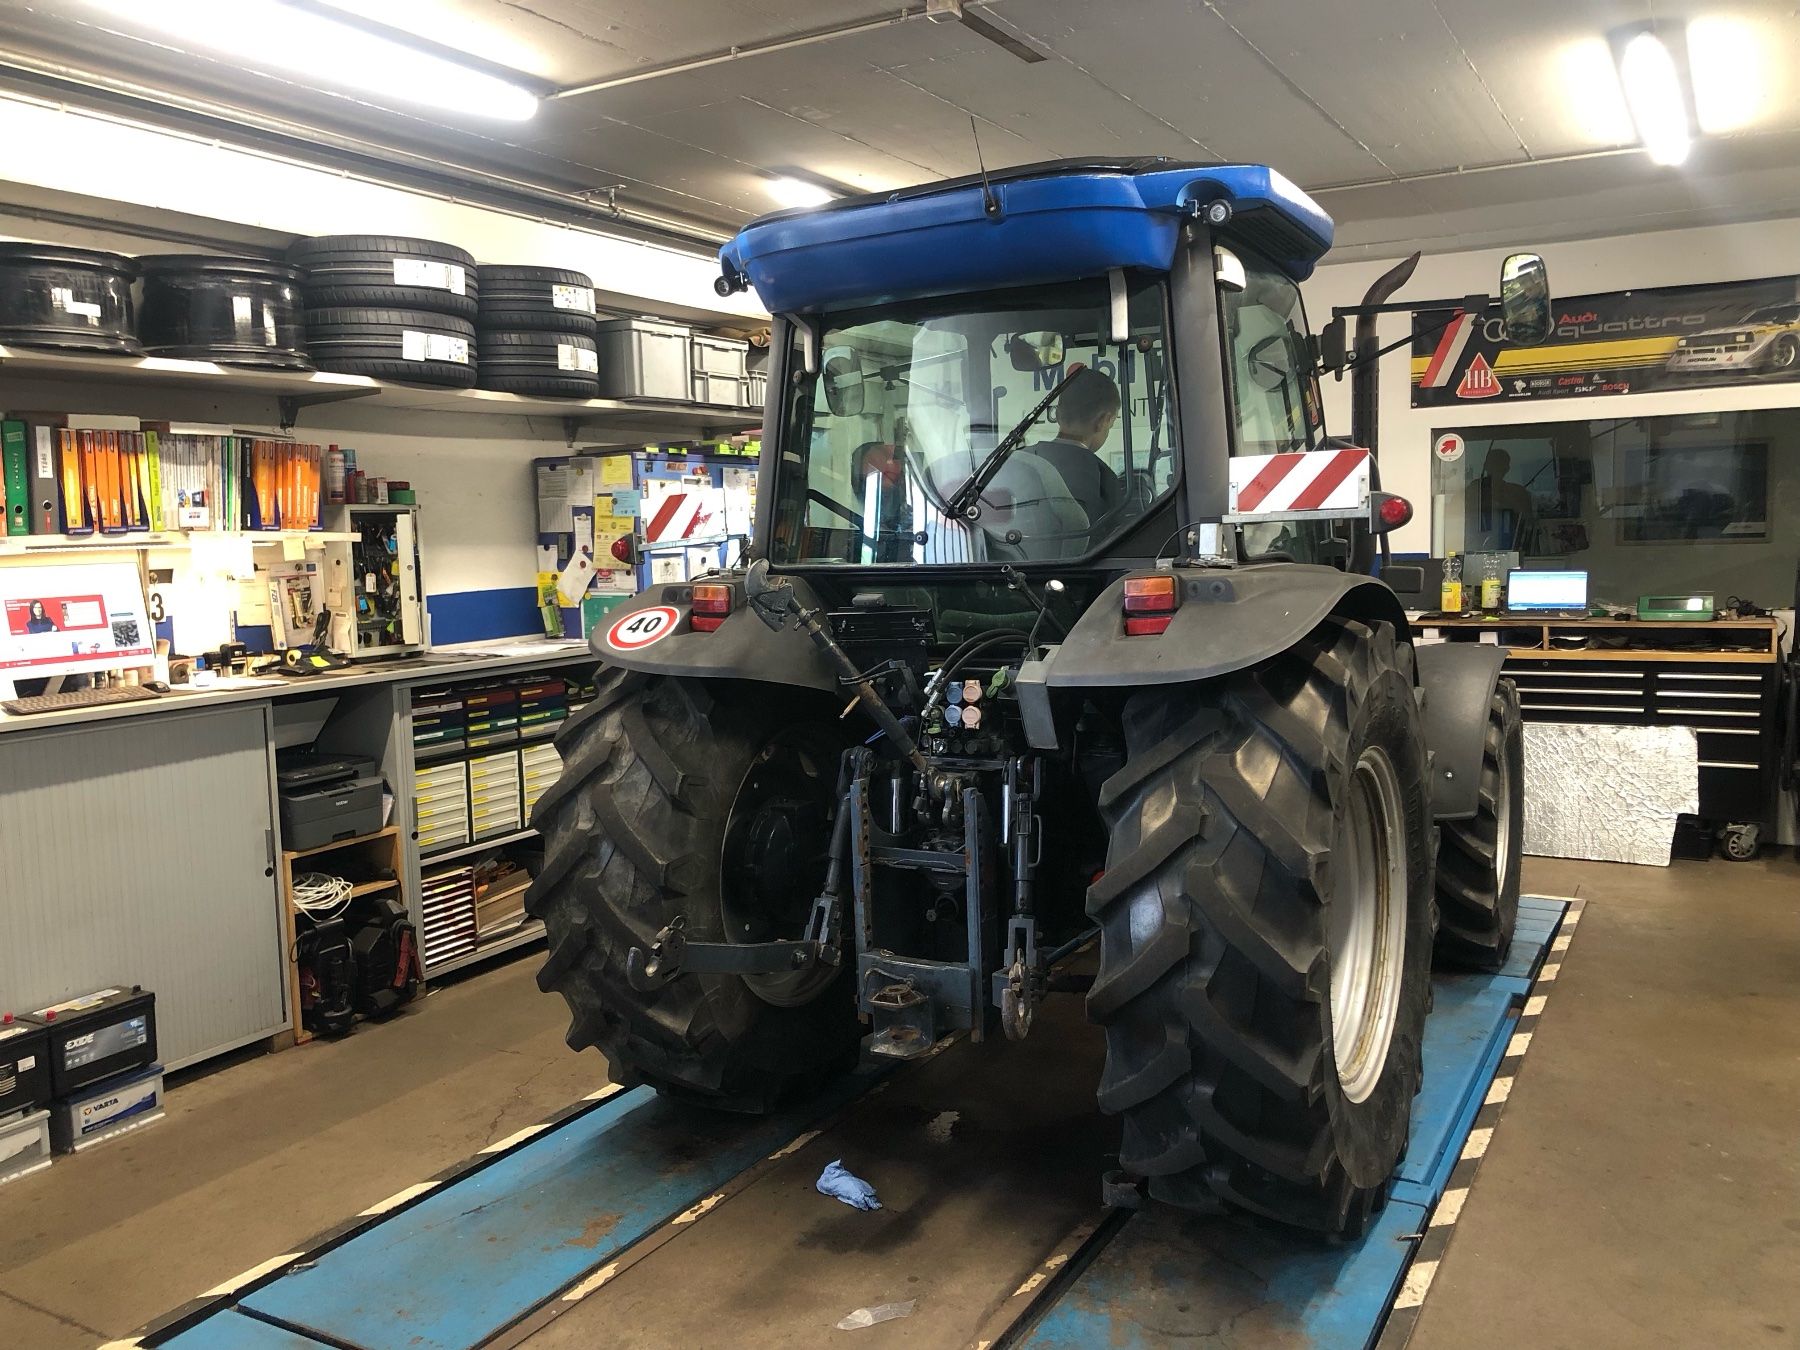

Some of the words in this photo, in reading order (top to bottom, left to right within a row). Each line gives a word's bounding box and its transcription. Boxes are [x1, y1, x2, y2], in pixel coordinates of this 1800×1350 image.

[1558, 312, 1598, 325] Audi
[1557, 314, 1706, 339] quattro
[1465, 369, 1493, 389] HB
[1557, 376, 1585, 386] Castrol
[1574, 386, 1597, 394] SKF
[1602, 383, 1630, 391] BOSCH
[151, 592, 164, 622] 3
[625, 616, 662, 633] 40
[64, 1032, 95, 1050] EXIDE
[93, 1098, 119, 1111] VARTA
